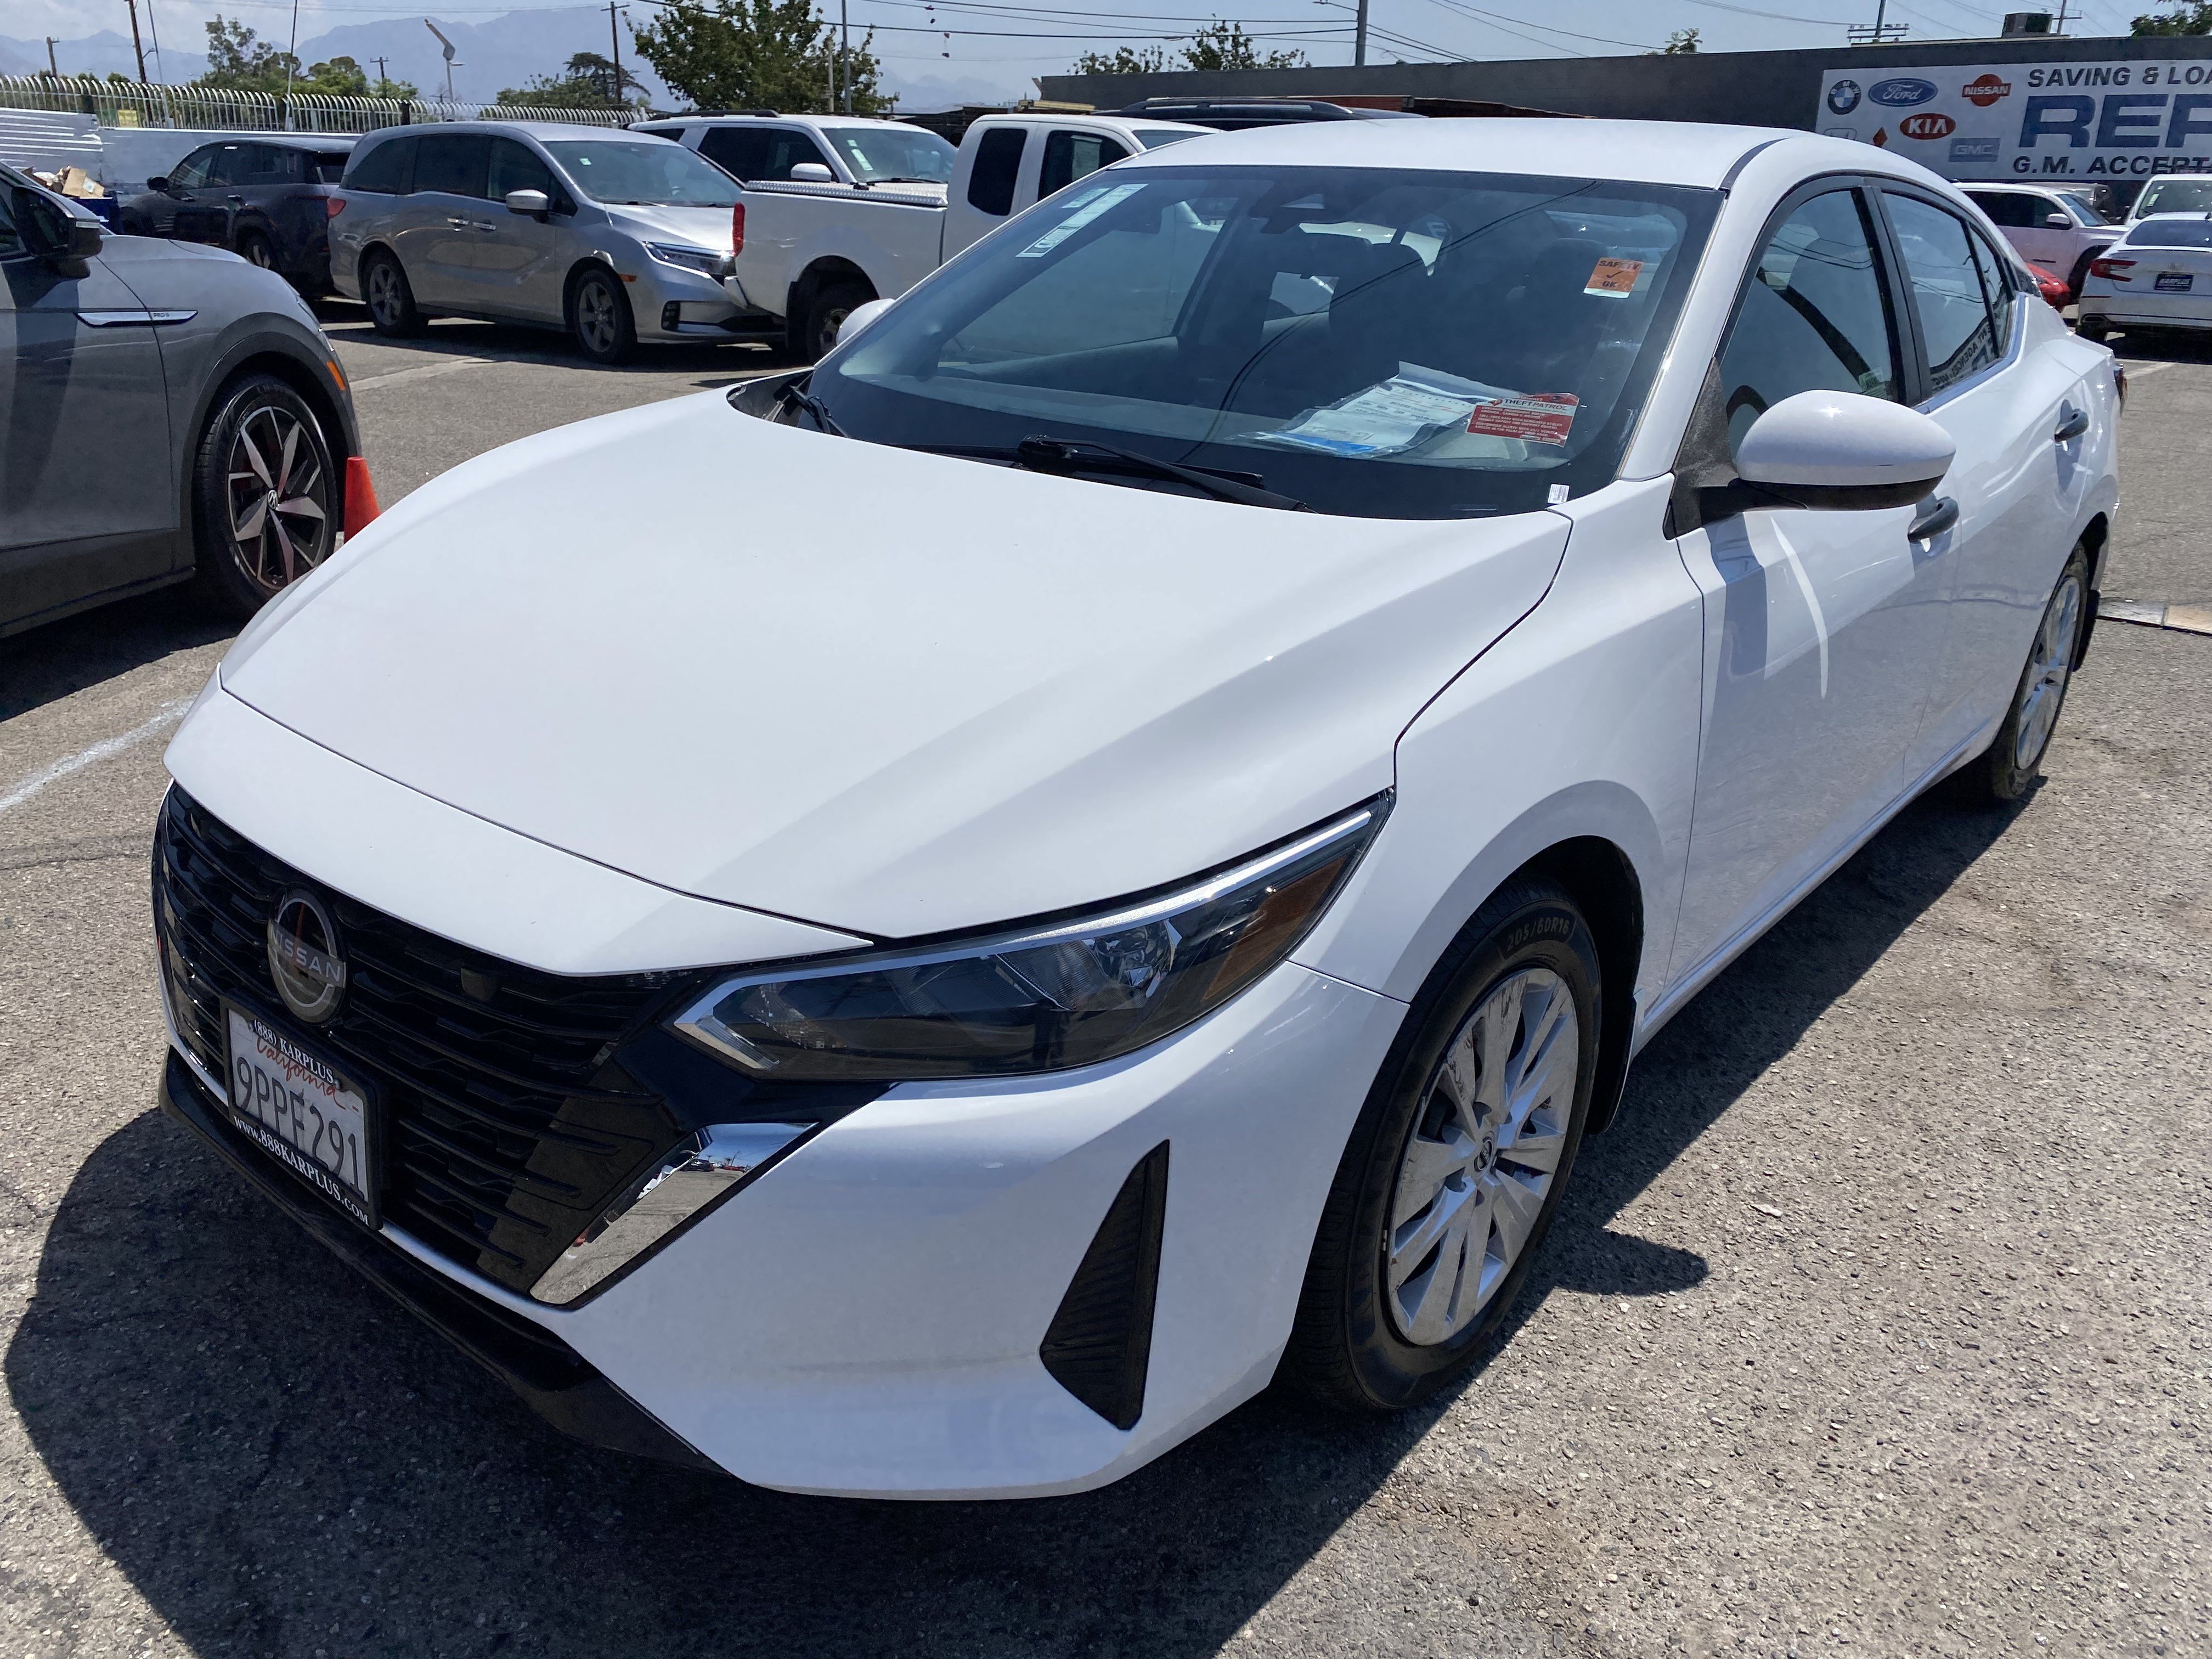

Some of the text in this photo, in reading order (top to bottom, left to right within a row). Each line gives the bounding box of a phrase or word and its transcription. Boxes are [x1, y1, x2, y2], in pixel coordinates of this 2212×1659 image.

[2028, 67, 2131, 87] SAVING
[2142, 66, 2159, 84] &
[1883, 84, 1922, 100] Ford
[1965, 86, 2008, 95] NISSAN
[1909, 118, 1948, 134] KIA
[1955, 145, 1994, 155] GMC
[2013, 156, 2212, 174] G.M. ACCEPT
[1599, 261, 1641, 270] SAFETY
[1508, 917, 1569, 951] 205/60R16
[276, 929, 340, 982] NISSAN
[254, 1019, 334, 1084] (888) KARPLUS
[236, 1057, 362, 1196] 9PPF291
